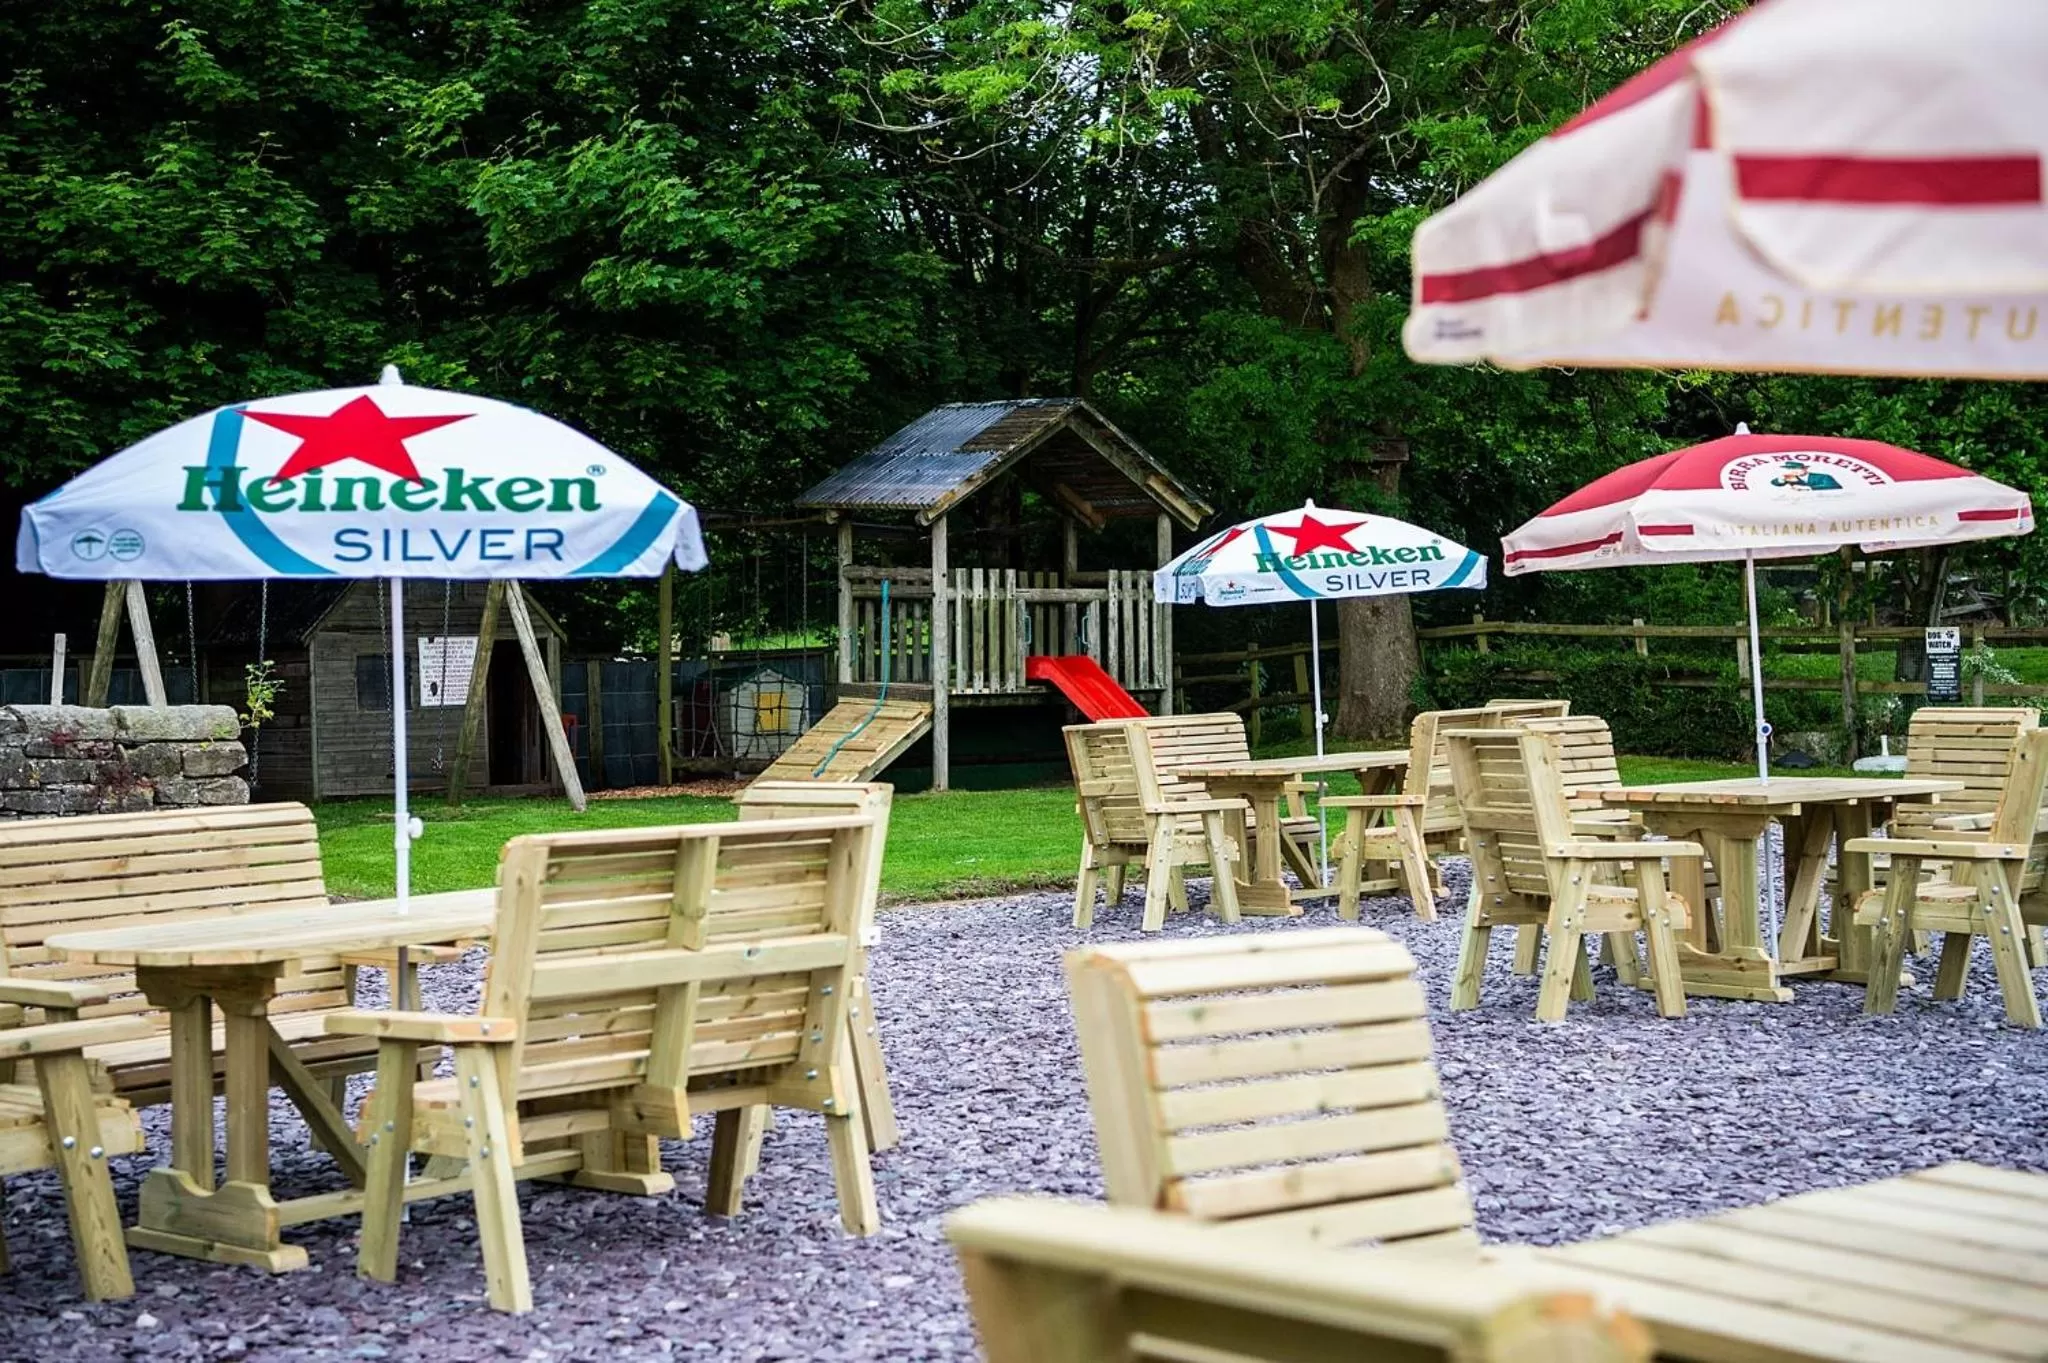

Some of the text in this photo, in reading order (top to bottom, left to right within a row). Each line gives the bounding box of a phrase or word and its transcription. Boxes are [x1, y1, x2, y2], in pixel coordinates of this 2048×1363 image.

[1728, 453, 1886, 491] BIRRA MORETTI
[177, 465, 602, 513] Heineken
[1829, 515, 1938, 533] AUTENTICA
[333, 528, 565, 562] SILVER
[1253, 544, 1446, 573] Heineken
[1326, 569, 1431, 591] SILVER
[1928, 641, 1952, 649] WATCH
